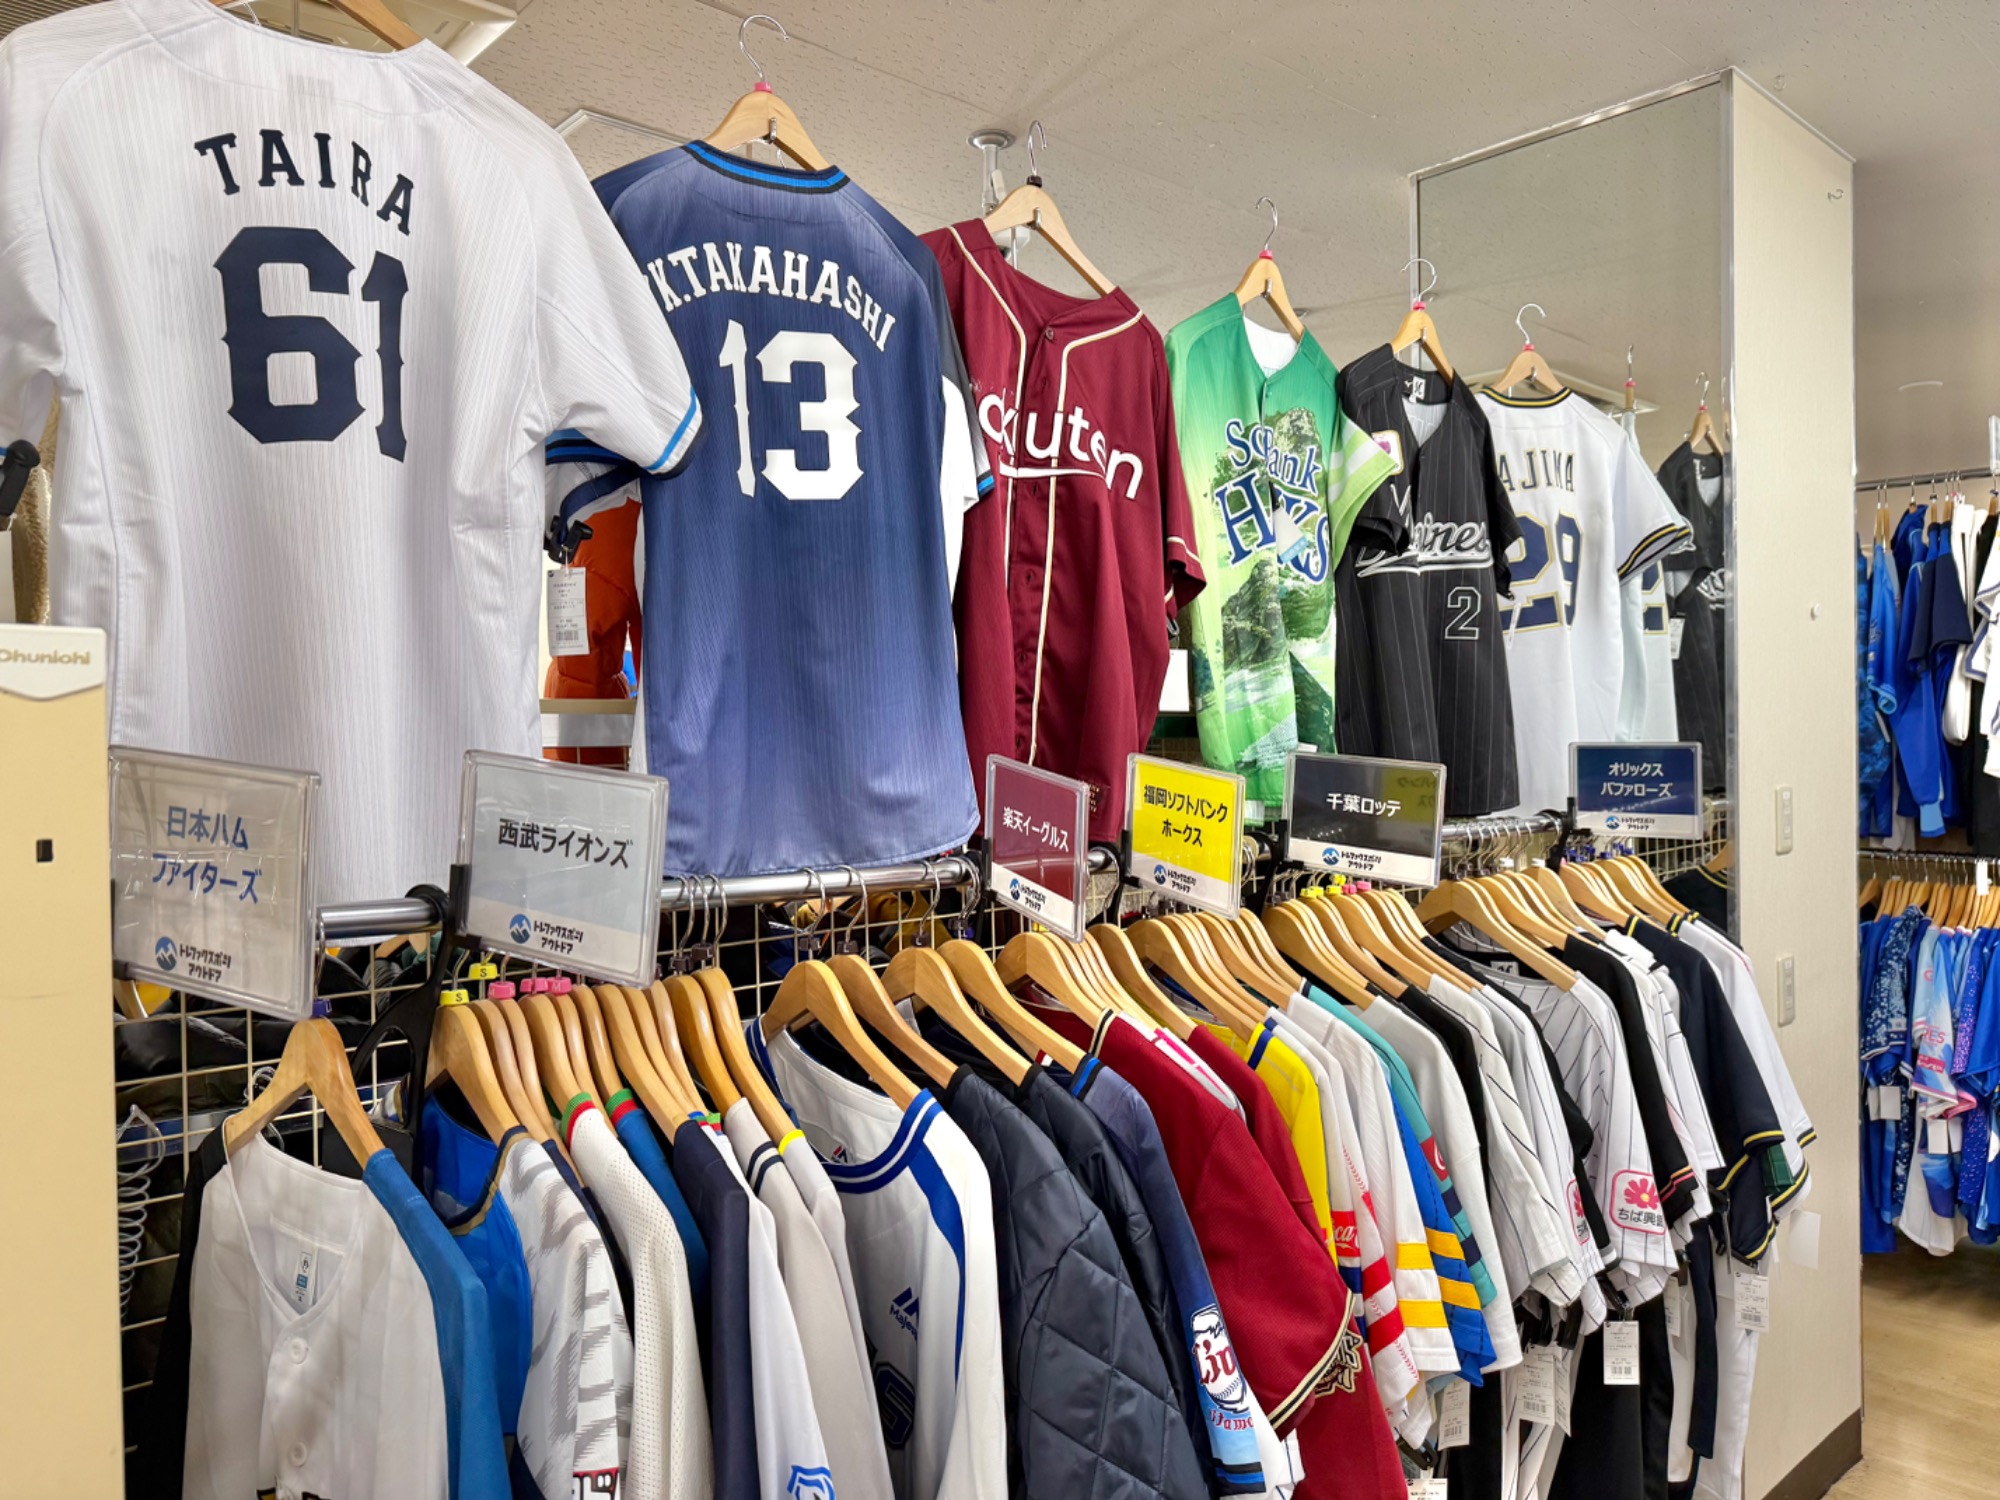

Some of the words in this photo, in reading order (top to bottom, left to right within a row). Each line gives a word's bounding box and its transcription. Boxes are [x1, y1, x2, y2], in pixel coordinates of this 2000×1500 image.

[195, 129, 414, 236] TAIRA
[647, 242, 896, 352] K.TAKAHASHI
[213, 227, 409, 463] 61
[719, 319, 864, 501] 13
[978, 388, 1144, 500] akuten
[1499, 450, 1575, 493] AJIMA
[1499, 511, 1584, 635] 29
[1445, 586, 1482, 640] 2
[1600, 782, 1674, 798] バファローズ
[1608, 762, 1664, 777] オリックス
[167, 805, 249, 850] 日本ハム
[1143, 784, 1229, 824] 福岡ソフトバンク
[1326, 793, 1402, 818] 千葉ロッテ
[498, 818, 634, 869] 西武ライオンズ
[1002, 806, 1070, 853] 楽天イーグルス
[1161, 818, 1203, 848] ホークス
[152, 853, 263, 905] ファイターズ
[541, 936, 574, 955] アウトドア
[188, 963, 222, 983] アウトドア
